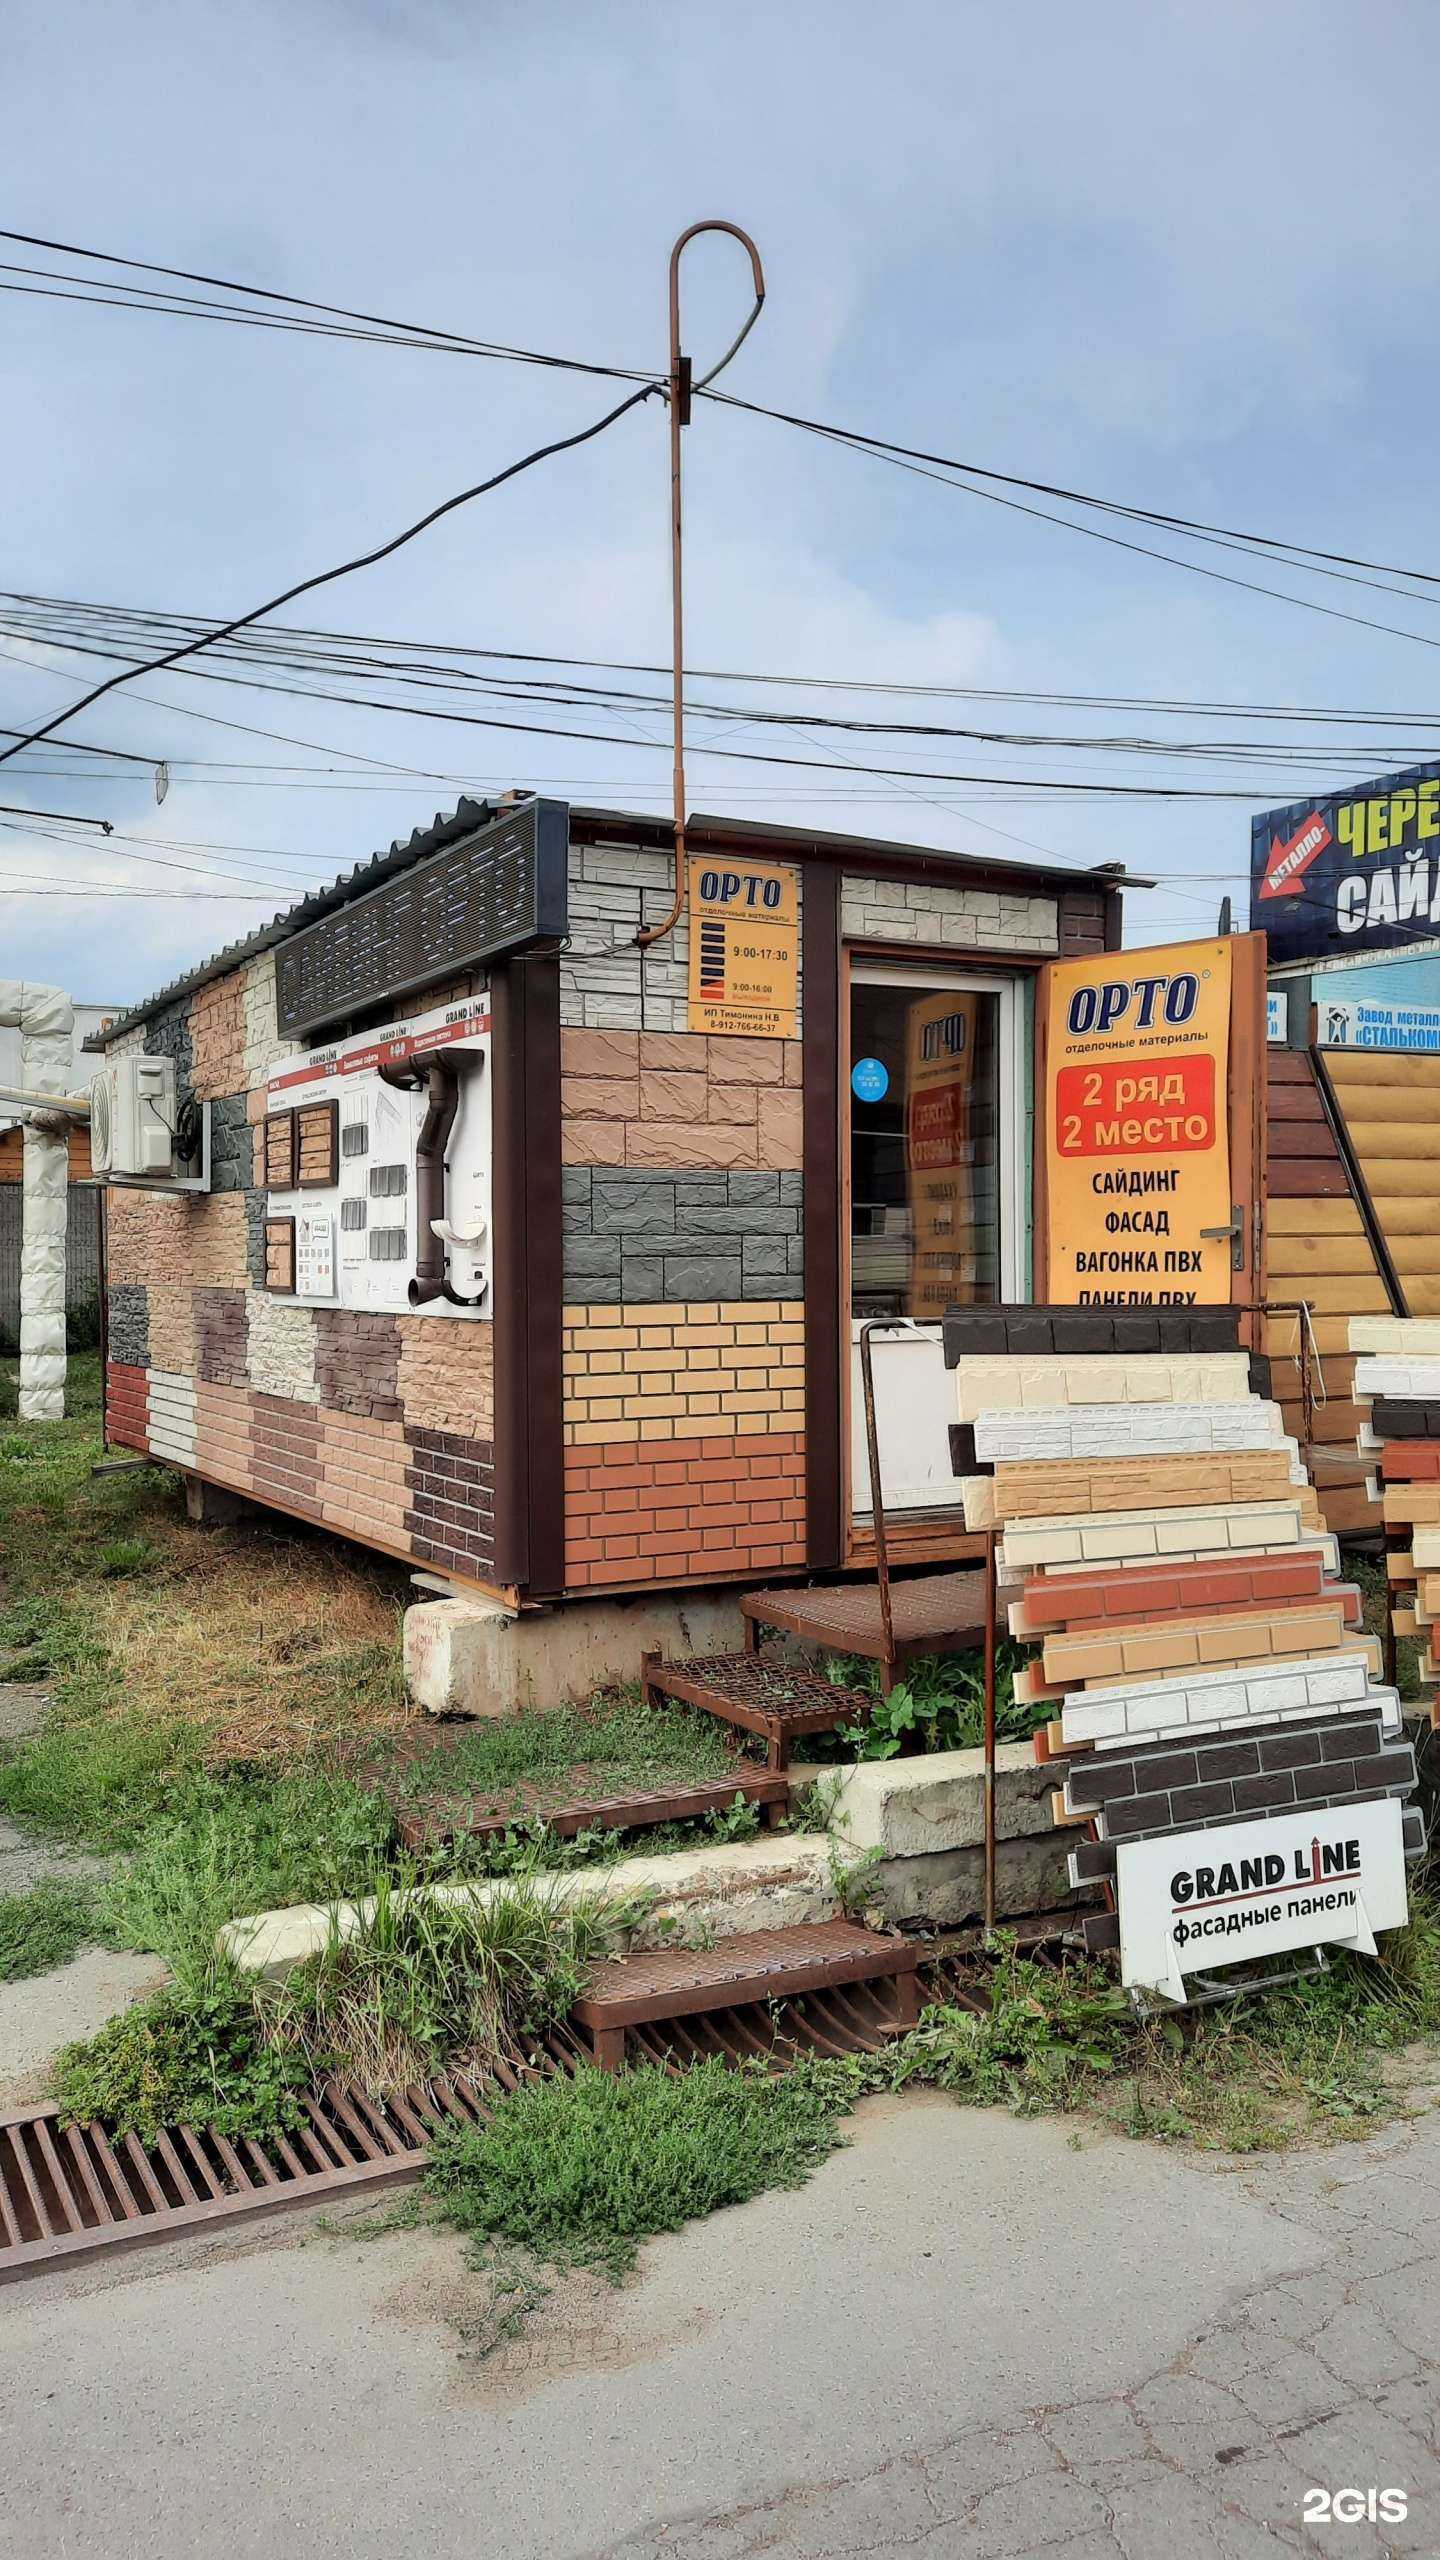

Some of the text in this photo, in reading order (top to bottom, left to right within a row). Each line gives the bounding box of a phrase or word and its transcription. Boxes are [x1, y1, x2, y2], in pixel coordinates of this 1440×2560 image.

[1337, 779, 1440, 858] ЧЕРЕ
[1266, 824, 1328, 891] МЕТАЛЛО-
[700, 871, 782, 909] ОРТО
[733, 946, 788, 961] 9:00-17:30
[446, 1001, 485, 1025] GRAND LINE
[704, 1008, 718, 1017] ИП
[1067, 972, 1200, 1036] ОРТО
[1357, 1006, 1393, 1026] Завод
[1065, 1031, 1209, 1054] отделочные материалы
[1356, 1025, 1440, 1049] «СТАЛЬКОМ
[1083, 1072, 1186, 1112] 2 ряд
[1062, 1114, 1209, 1148] 2 место
[1092, 1169, 1181, 1196] САЙДИНГ
[1105, 1210, 1170, 1236] ФАСАД
[1075, 1250, 1203, 1274] ВАГОНКА ПВХ
[1170, 1837, 1362, 1904] GRAND LINE
[1173, 1905, 1282, 1947] фасадные
